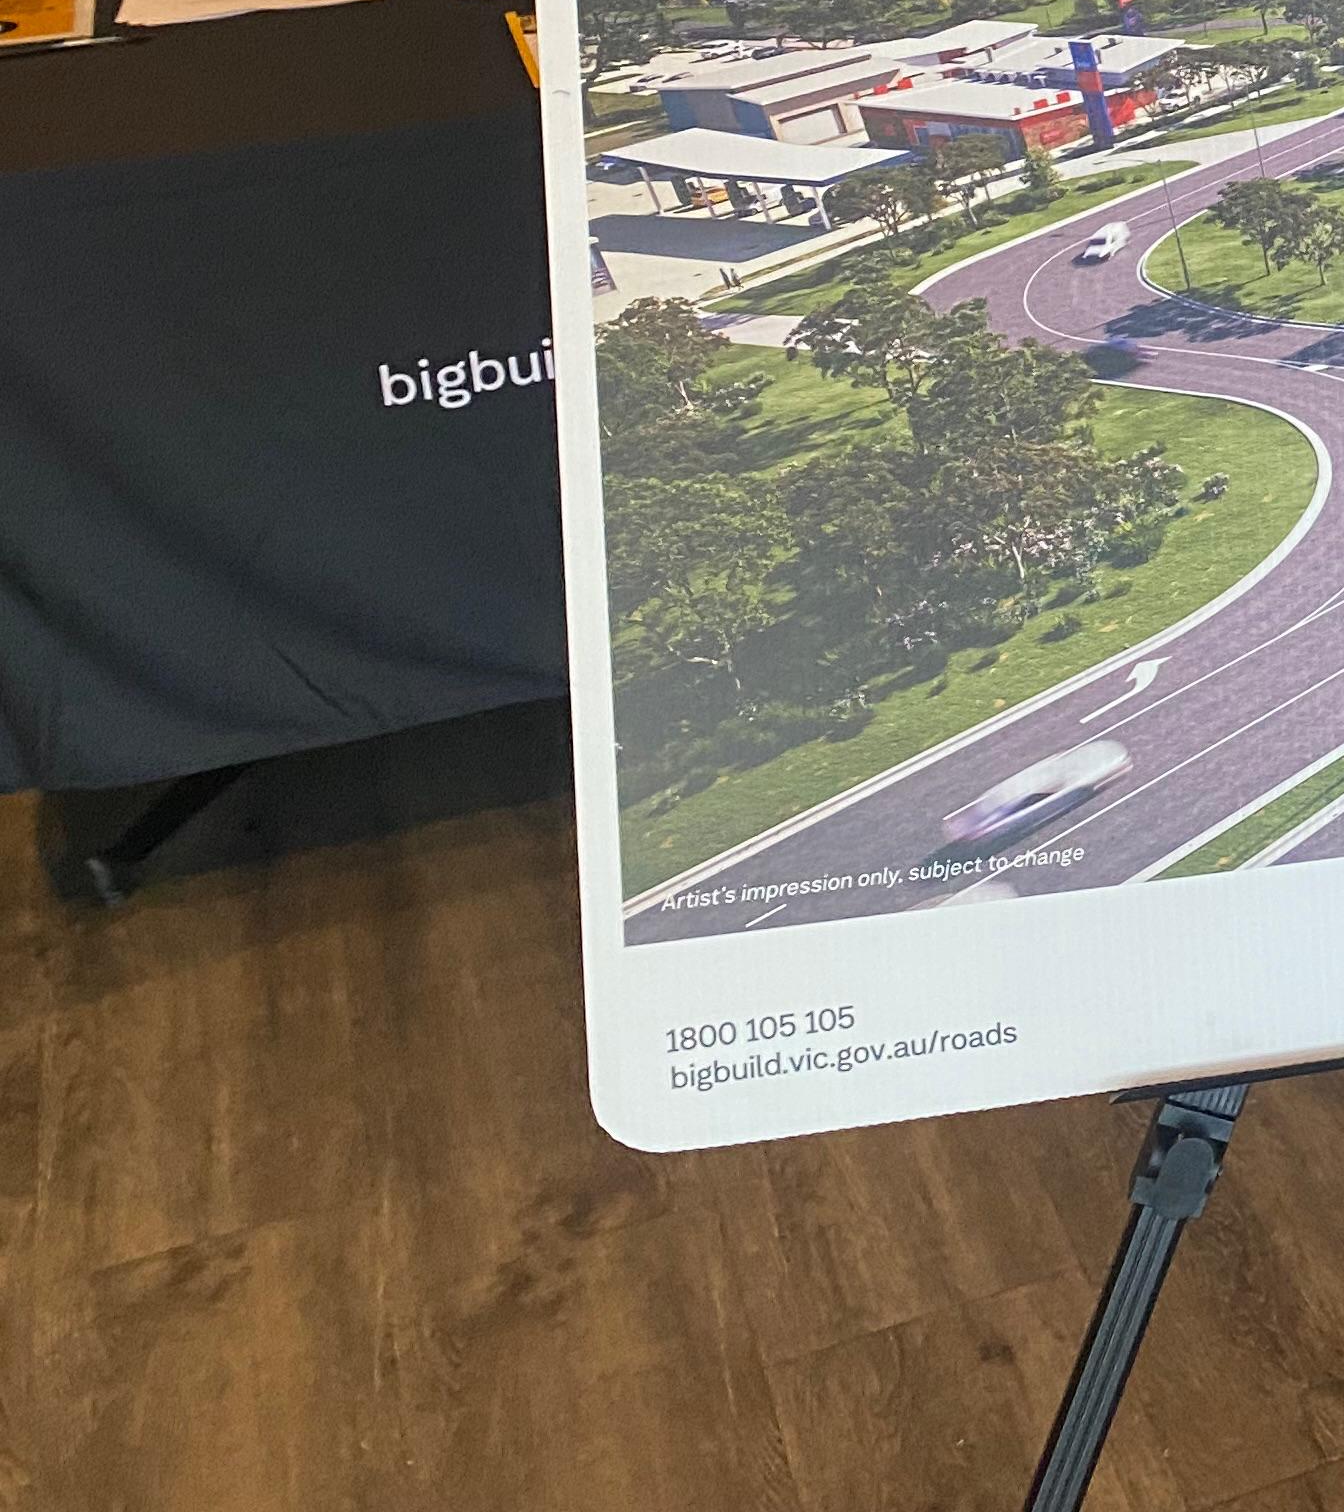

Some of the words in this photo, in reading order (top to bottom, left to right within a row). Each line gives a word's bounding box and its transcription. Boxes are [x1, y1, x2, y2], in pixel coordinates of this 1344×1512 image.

[661, 885, 736, 913] Artist's
[740, 873, 853, 905] impression
[908, 857, 983, 882] subject
[988, 854, 1009, 872] to
[1013, 845, 1086, 870] change
[666, 1021, 738, 1054] 1800
[746, 1014, 797, 1043] 105
[805, 1005, 856, 1035] 105
[671, 1022, 1018, 1093] bigbuild.vic.gov.au/roads
